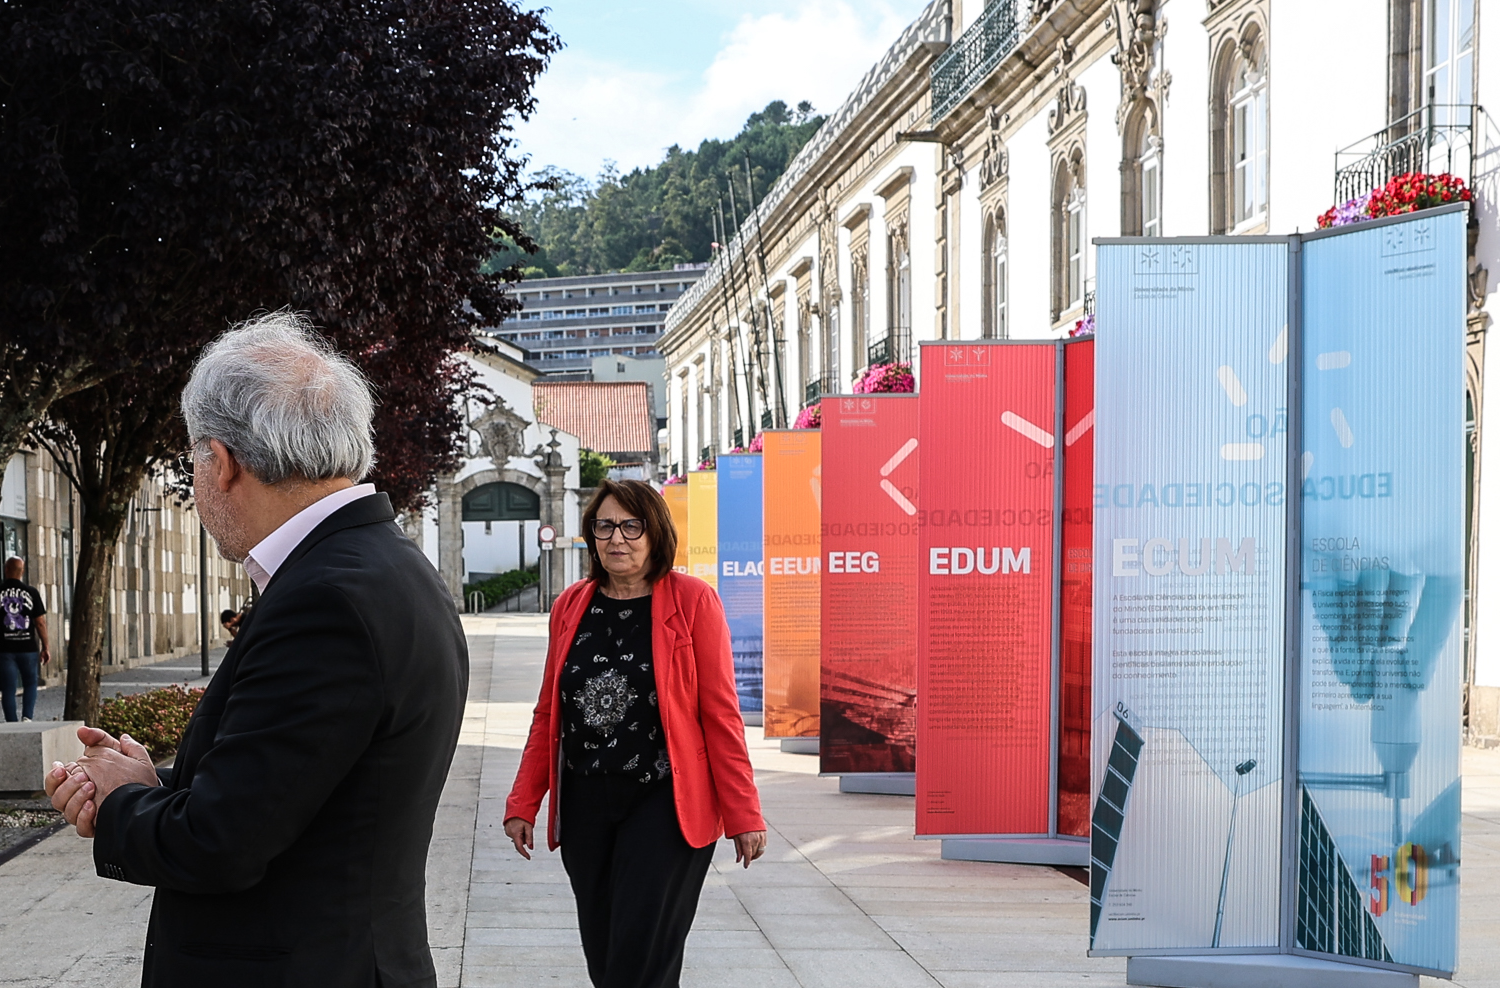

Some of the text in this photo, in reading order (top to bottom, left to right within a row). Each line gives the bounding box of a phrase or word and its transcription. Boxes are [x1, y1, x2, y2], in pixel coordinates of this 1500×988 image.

[1113, 537, 1256, 577] ECUM
[1313, 537, 1360, 552] ESCOLA
[828, 551, 880, 573] EEG
[929, 547, 1031, 575] EDUM
[1313, 555, 1389, 573] DE CIÊNCIAS
[1370, 842, 1428, 917] 50
